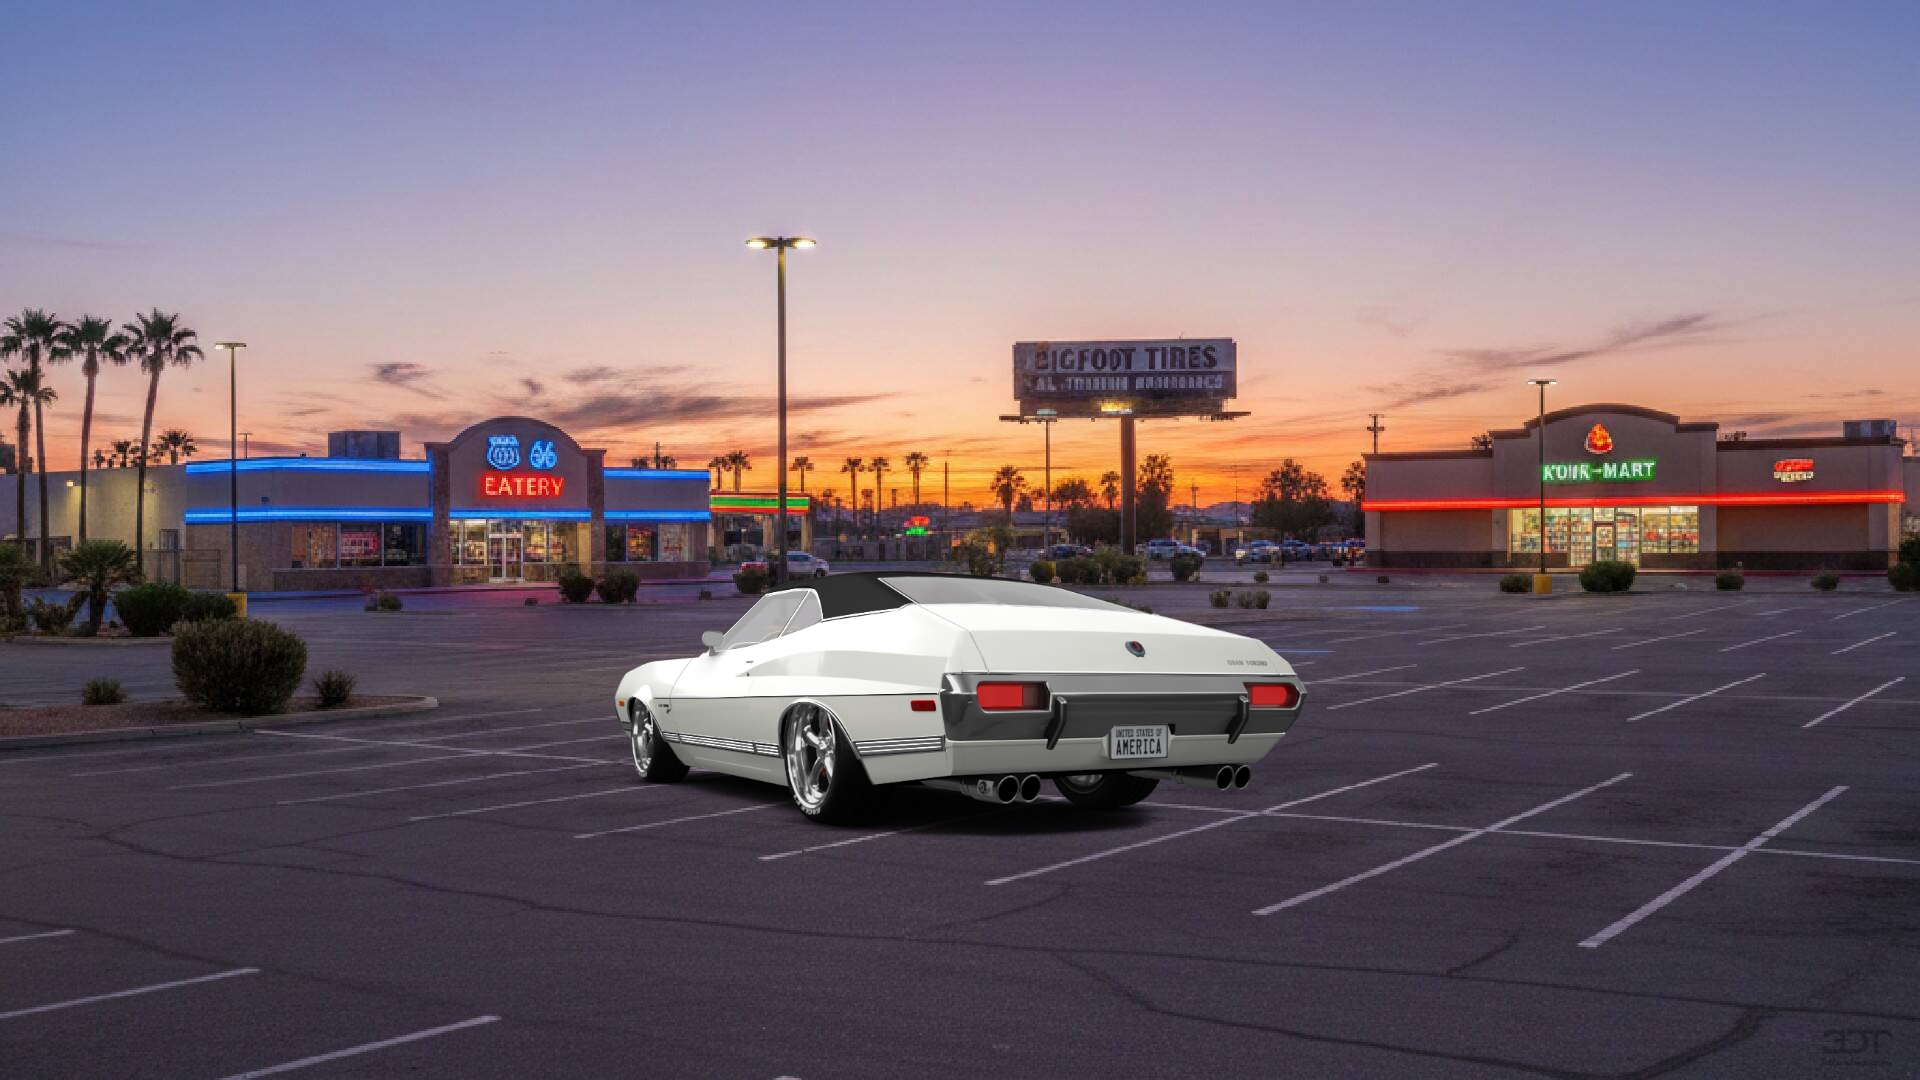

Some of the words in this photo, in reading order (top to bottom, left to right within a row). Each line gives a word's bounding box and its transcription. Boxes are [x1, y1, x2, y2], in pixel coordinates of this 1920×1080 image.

[1034, 348, 1136, 371] BIGFOOT
[1144, 345, 1218, 370] TIRES
[485, 476, 565, 496] EATERY
[1115, 729, 1134, 738] UNITED
[1136, 728, 1154, 737] STATES
[1156, 728, 1162, 737] OF
[1116, 738, 1161, 755] AMERICA
